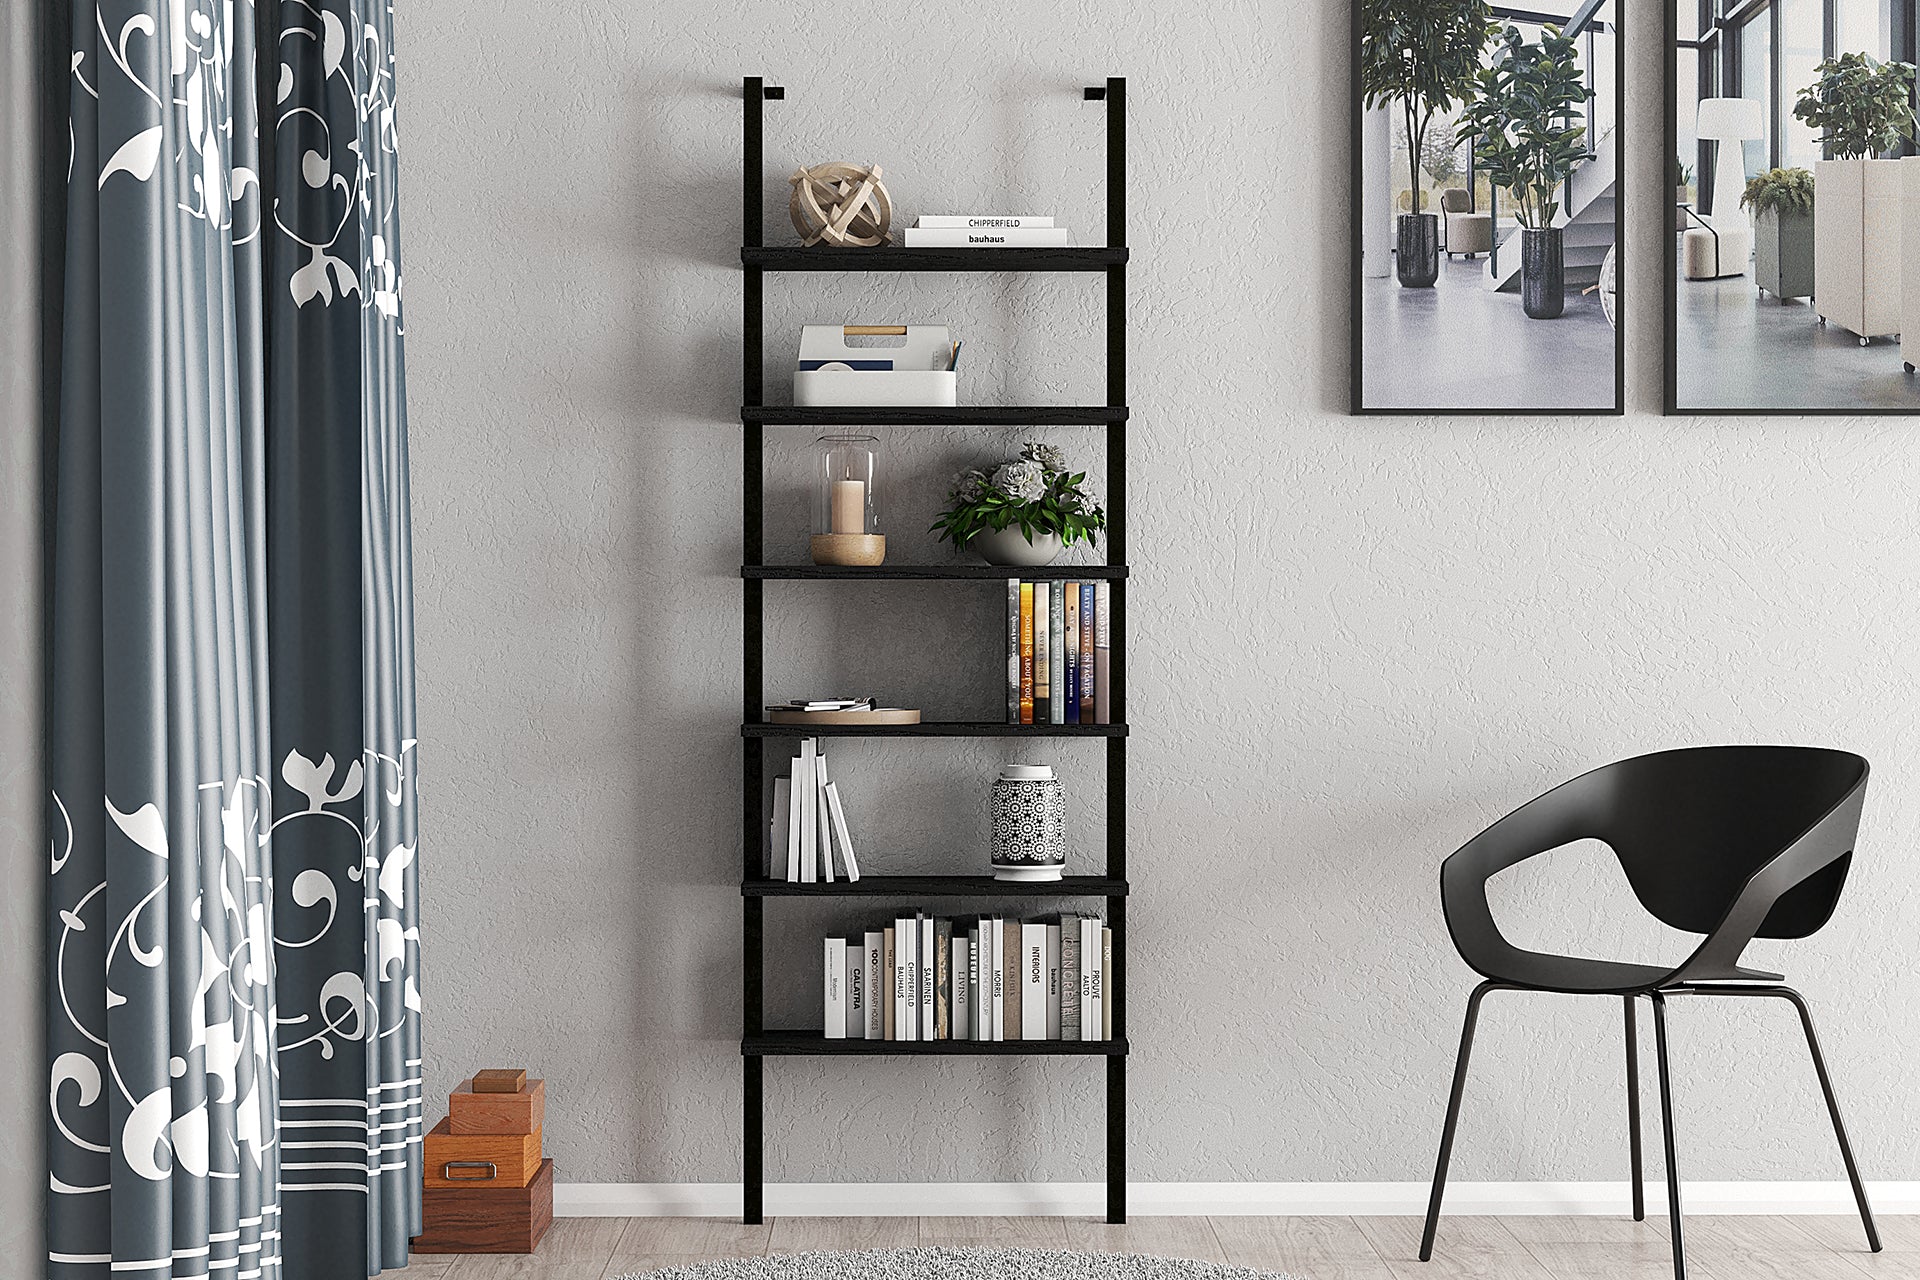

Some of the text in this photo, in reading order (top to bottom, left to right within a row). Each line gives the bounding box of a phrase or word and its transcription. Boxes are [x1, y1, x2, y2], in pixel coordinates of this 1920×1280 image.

[968, 219, 1020, 227] CHIPPERFIELD
[968, 235, 1005, 243] bauhaus
[1084, 652, 1090, 663] ON
[1032, 946, 1040, 984] INTERIORS
[1063, 937, 1074, 1016] CONCRETE
[853, 968, 861, 1010] CALATRA
[1092, 970, 1101, 1000] PROUVÉ
[871, 1008, 879, 1031] HOUSES
